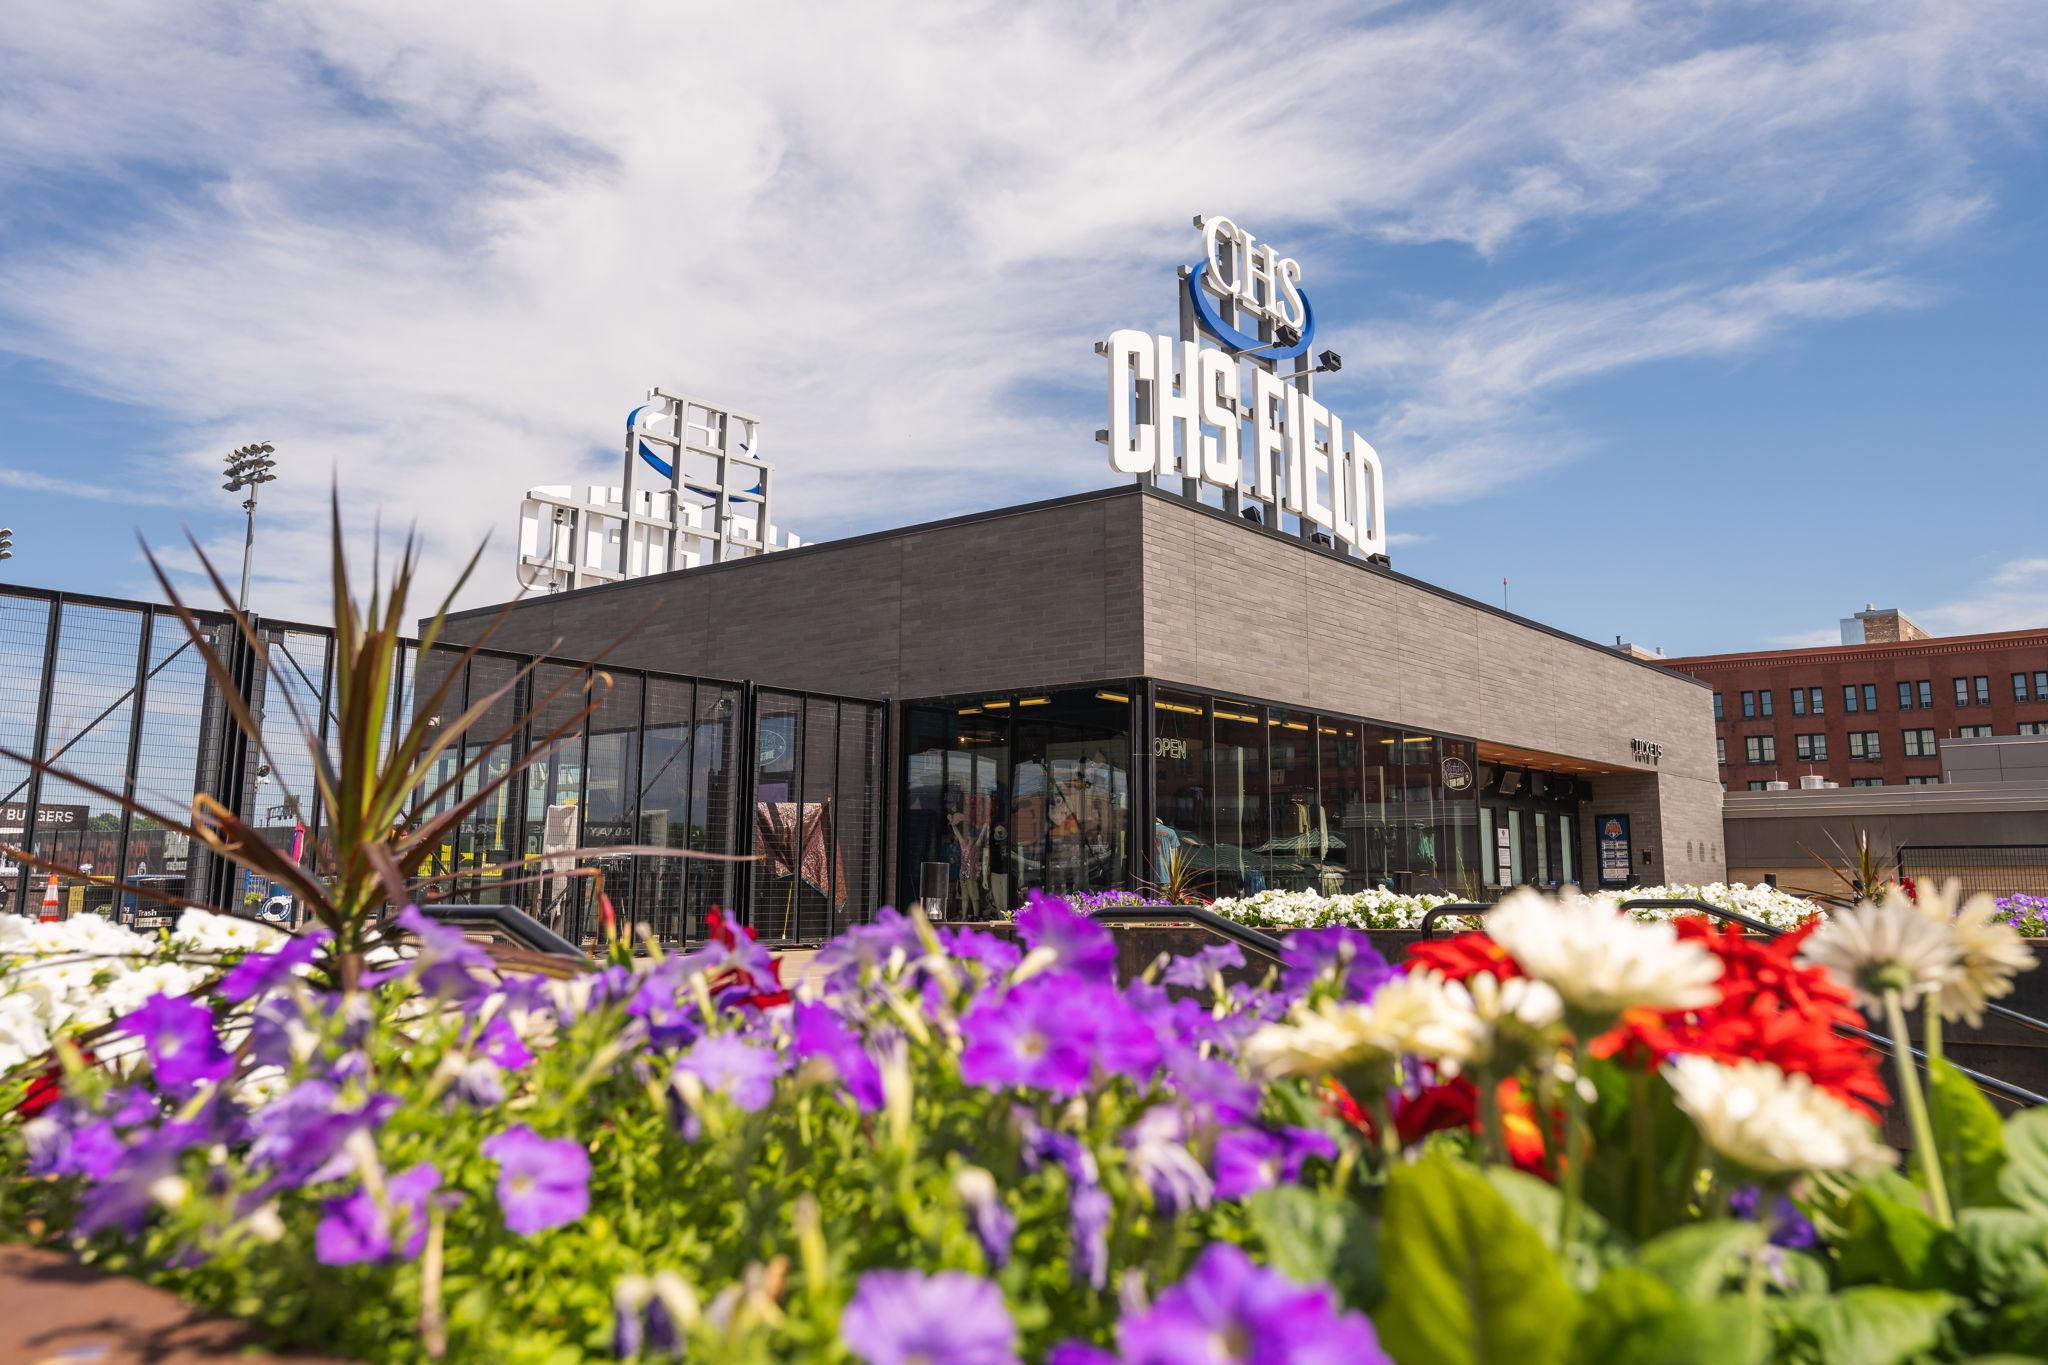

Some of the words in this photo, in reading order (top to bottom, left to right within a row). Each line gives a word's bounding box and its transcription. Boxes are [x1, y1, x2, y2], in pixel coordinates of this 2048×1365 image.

[1201, 215, 1304, 330] CHS
[1107, 328, 1240, 490] CHS
[1252, 366, 1387, 559] FIELD
[1153, 736, 1187, 760] OPEN
[1633, 738, 1663, 759] TICKETS
[6, 808, 74, 823] BUGERS
[137, 908, 158, 918] Trash
